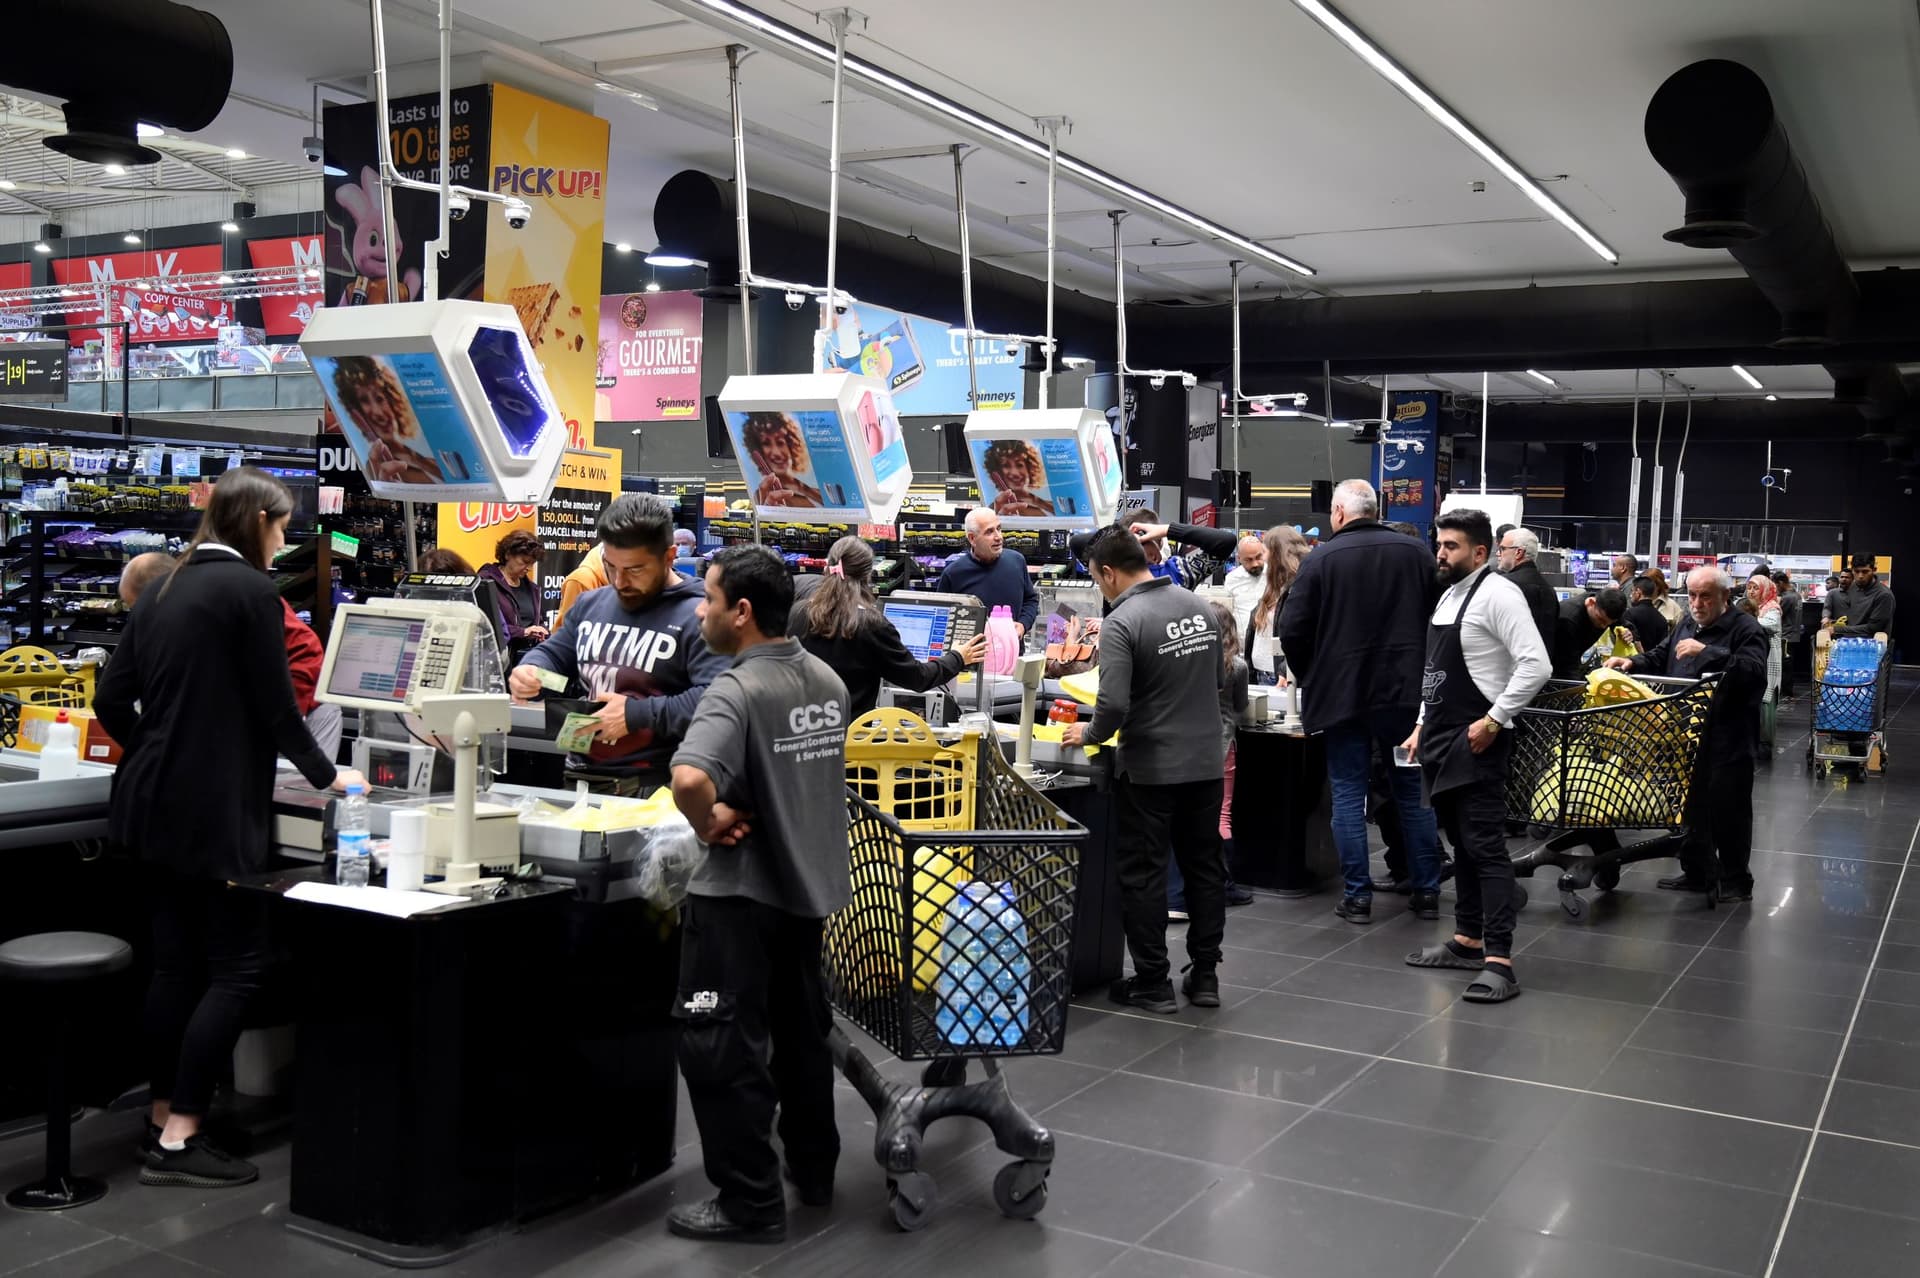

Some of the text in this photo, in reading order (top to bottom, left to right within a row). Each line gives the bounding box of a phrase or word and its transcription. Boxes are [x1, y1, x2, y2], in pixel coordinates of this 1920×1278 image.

[389, 105, 426, 124] Lasts
[454, 99, 469, 115] to
[428, 125, 470, 144] ties
[390, 127, 423, 166] 10
[428, 145, 470, 163] loger
[558, 169, 601, 198] UP!
[144, 292, 205, 309] COPY CENTER
[636, 328, 684, 338] FOR EVERYTHING
[620, 336, 702, 367] GOURMET
[10, 366, 21, 379] 19
[653, 366, 679, 375] COOKING
[681, 365, 696, 374] CLUB
[656, 396, 695, 409] Spinneys
[966, 388, 1016, 403] Spinneys
[1189, 421, 1217, 442] Energizer
[580, 466, 586, 478] &
[588, 468, 607, 480] WIN
[551, 498, 561, 508] for
[562, 499, 572, 509] the
[573, 501, 593, 511] amount
[594, 502, 602, 511] of
[582, 515, 594, 524] from
[537, 525, 570, 537] DURACELL
[587, 527, 598, 538] and
[543, 540, 557, 550] win
[558, 541, 577, 551] instant
[1732, 556, 1756, 564] NIVEA
[1166, 614, 1208, 640] GCS
[789, 700, 842, 734] GCS
[773, 740, 807, 753] General
[803, 747, 840, 761] Services
